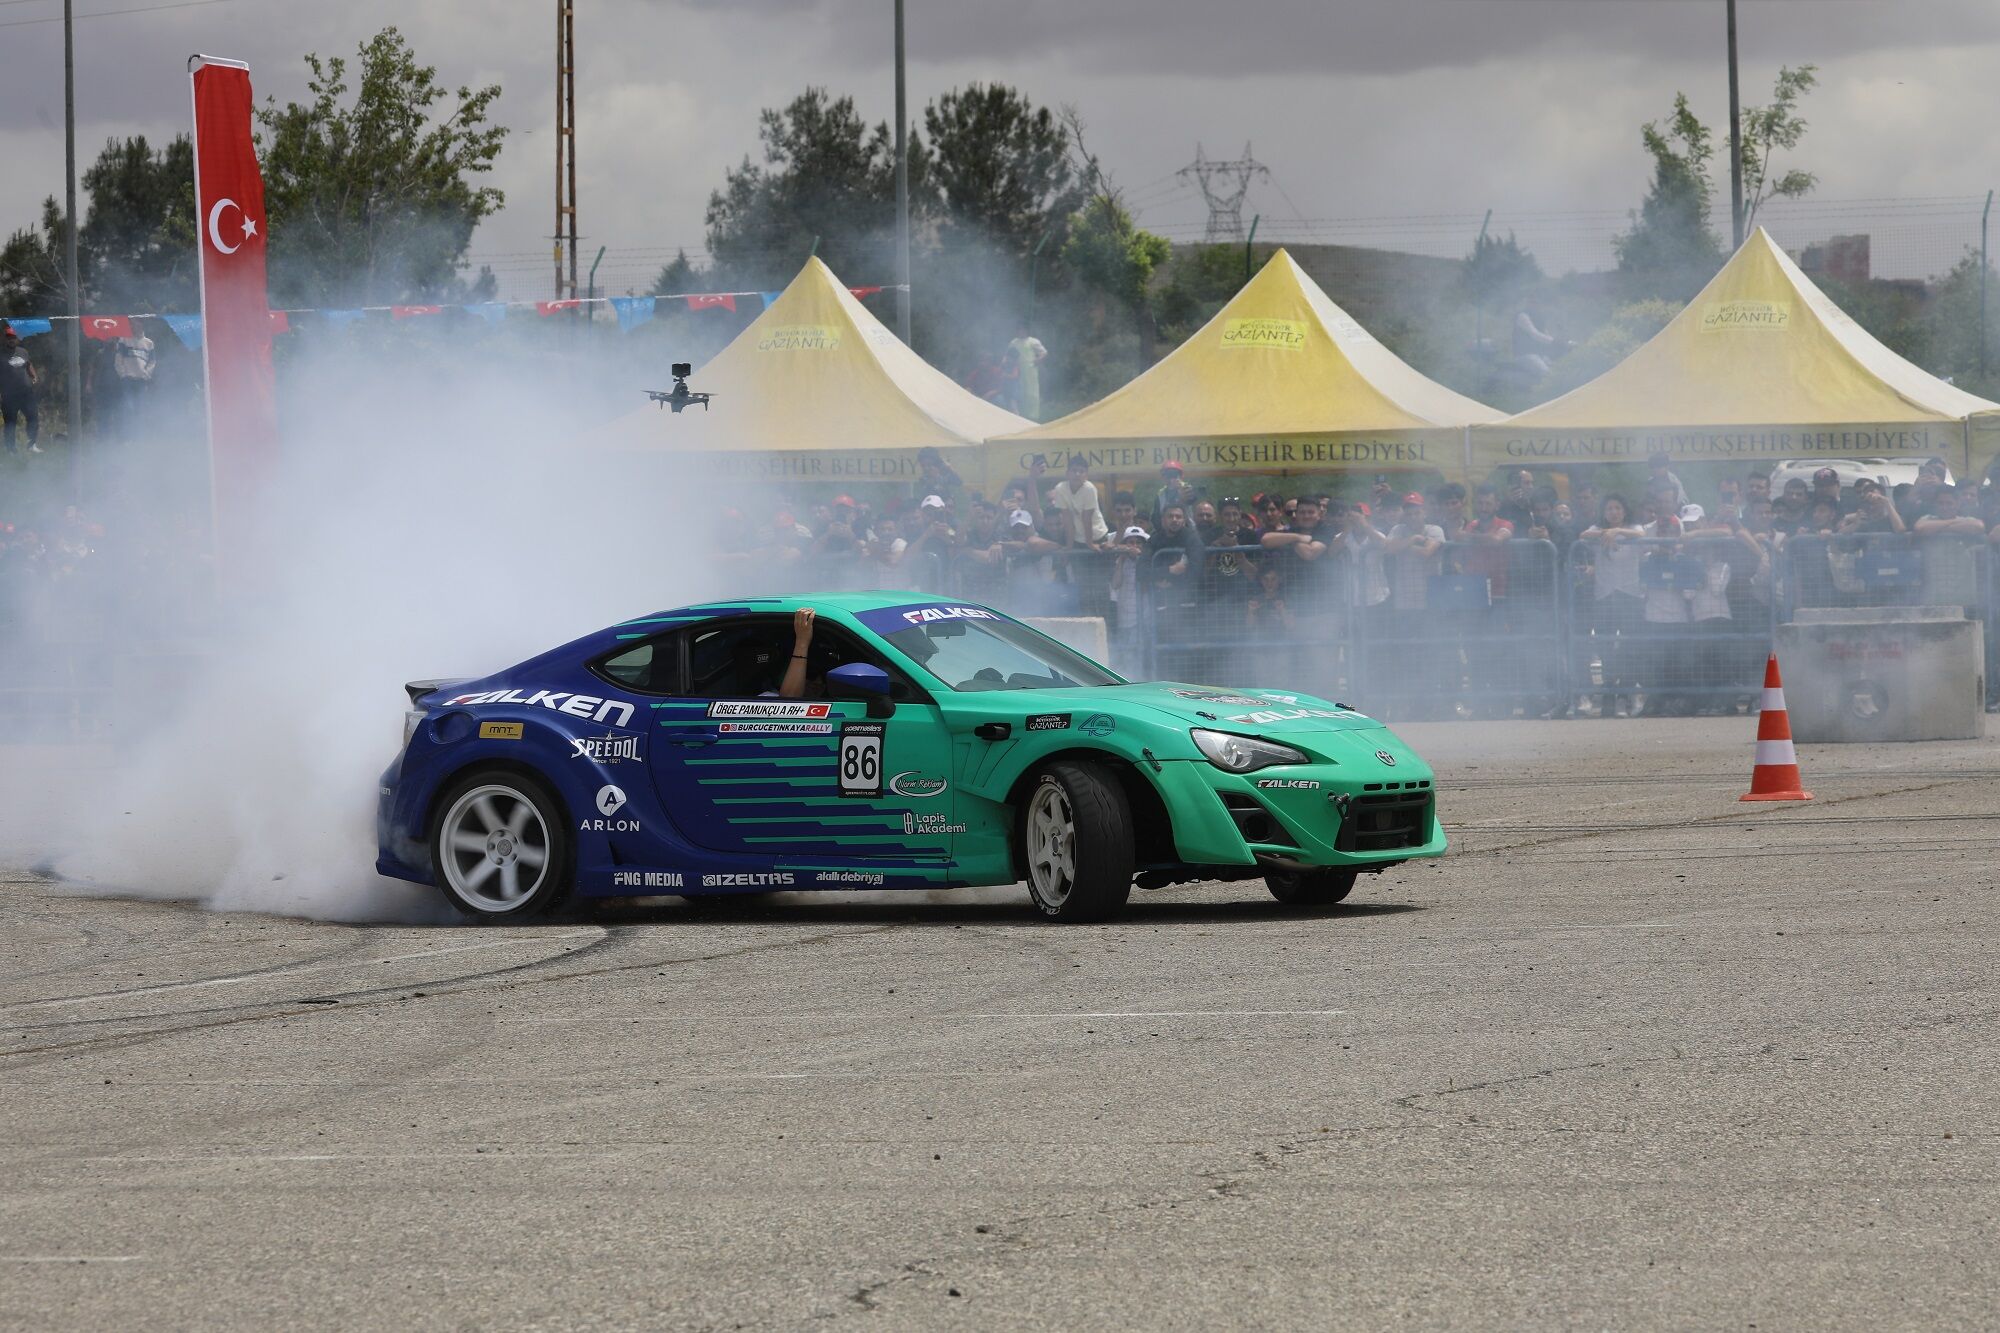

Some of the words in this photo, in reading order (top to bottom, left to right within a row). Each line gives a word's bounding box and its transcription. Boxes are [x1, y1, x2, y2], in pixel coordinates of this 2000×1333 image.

[1801, 428, 1929, 450] BELEDİYESİ
[1153, 441, 1297, 467] BÜYÜKŞEHİR
[1302, 440, 1425, 462] BELEDİYESİ
[700, 454, 823, 480] YÜKŞEHİR
[831, 455, 919, 476] BELEDİY
[903, 608, 1001, 624] FALKEN
[442, 689, 636, 727] FALKEN
[716, 703, 739, 715] ÖRGE
[738, 704, 780, 717] PAMUKÇU
[780, 705, 786, 715] A
[787, 705, 805, 716] RH+
[1224, 709, 1368, 724] FALKEN
[571, 737, 642, 762] SPEEDOL
[844, 745, 877, 780] 86
[1257, 779, 1320, 789] FALKEN
[581, 819, 640, 832] ARLON
[916, 813, 946, 825] Lapis
[918, 822, 966, 834] Akademi
[644, 872, 684, 887] MEDIA
[840, 871, 884, 885] debriyaj
